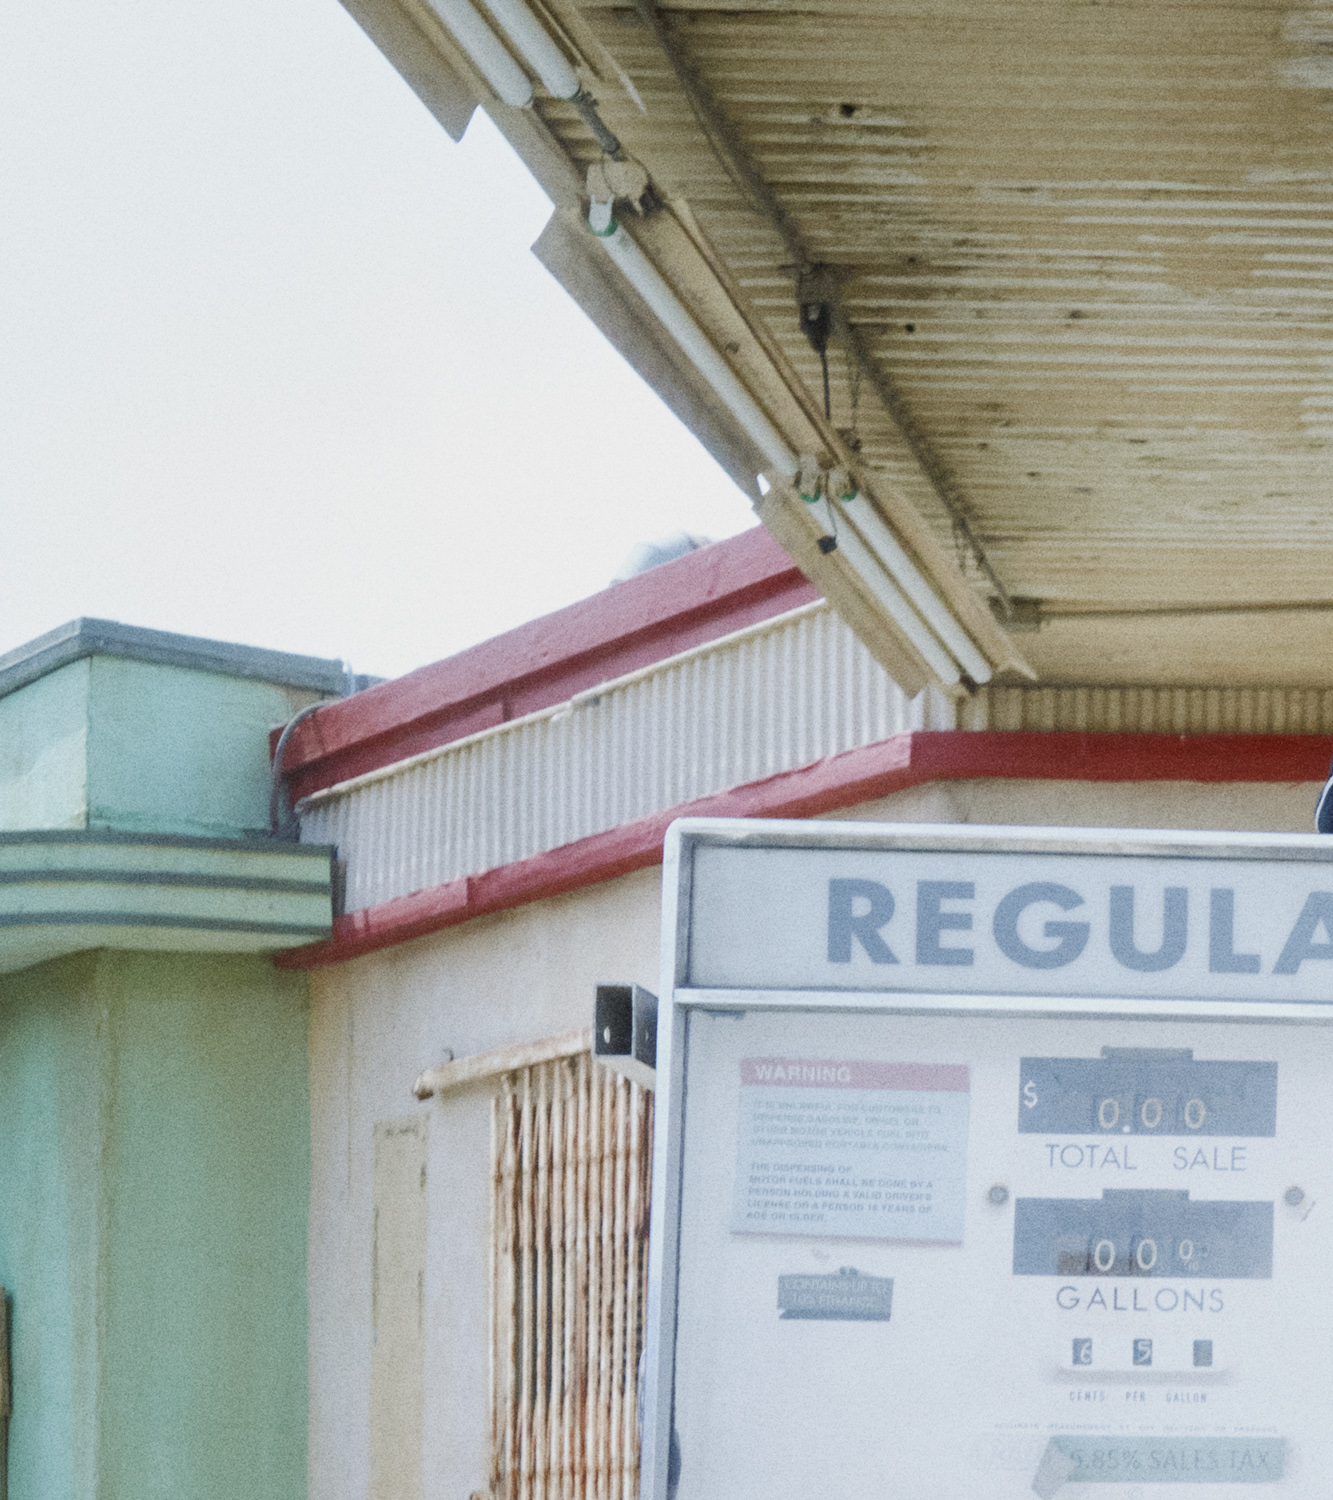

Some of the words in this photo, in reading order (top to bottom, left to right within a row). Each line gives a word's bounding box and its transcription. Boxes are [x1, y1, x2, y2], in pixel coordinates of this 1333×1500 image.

[755, 1064, 852, 1083] WARNING
[1023, 1079, 1038, 1109] $
[1045, 1143, 1138, 1172] TOTAL
[1173, 1145, 1247, 1173] SALE
[1056, 1285, 1225, 1313] GALLONS
[1069, 1390, 1105, 1403] CENTS
[1125, 1390, 1146, 1403] PER
[1166, 1391, 1207, 1404] GALLON
[1148, 1448, 1219, 1471] SALES
[1228, 1449, 1270, 1470] TAX
